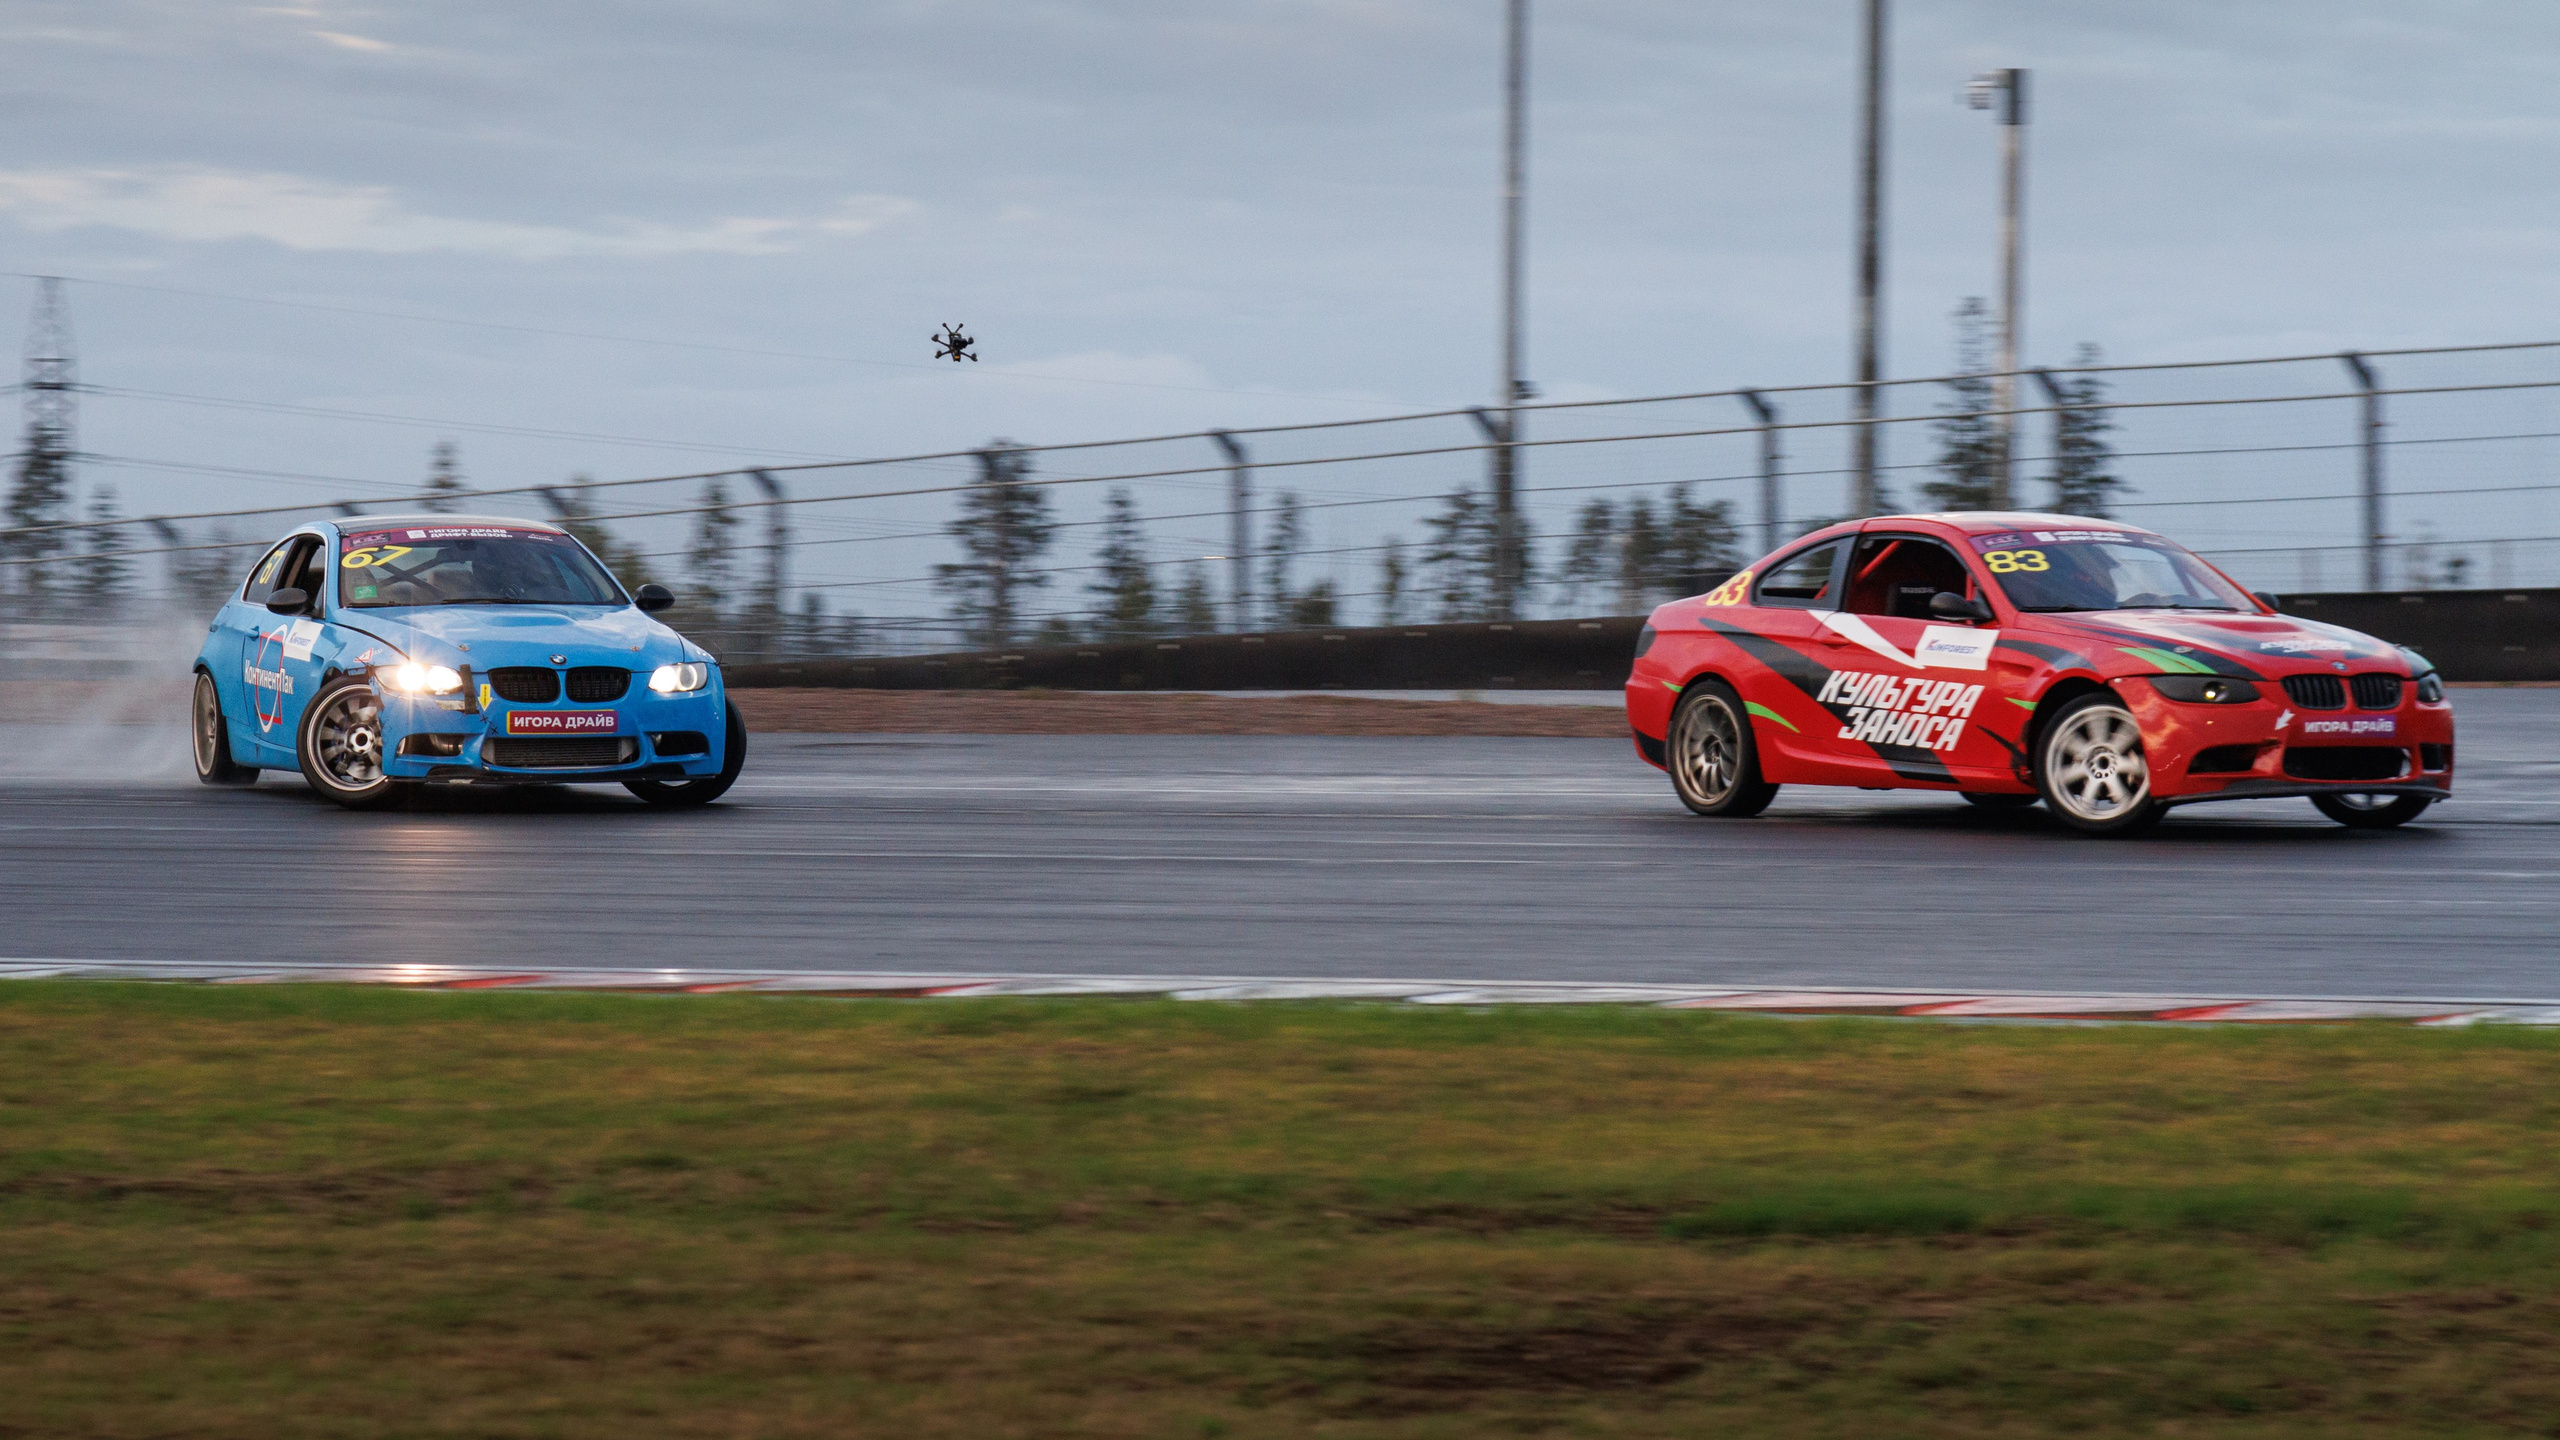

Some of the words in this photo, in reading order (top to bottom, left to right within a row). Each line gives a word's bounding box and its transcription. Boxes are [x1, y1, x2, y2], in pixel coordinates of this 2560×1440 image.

[259, 550, 286, 585] 67
[341, 545, 413, 569] 67
[1983, 550, 2050, 573] 83
[1706, 570, 1754, 606] 83
[1816, 670, 1986, 718] КУЛЬТУРА
[514, 716, 562, 727] ИГОРА
[565, 714, 615, 729] ДРАЙВ
[1837, 706, 1967, 752] ЗАНОСА
[2305, 721, 2350, 733] ИГОРА
[2351, 718, 2395, 733] ДРАЙВ
